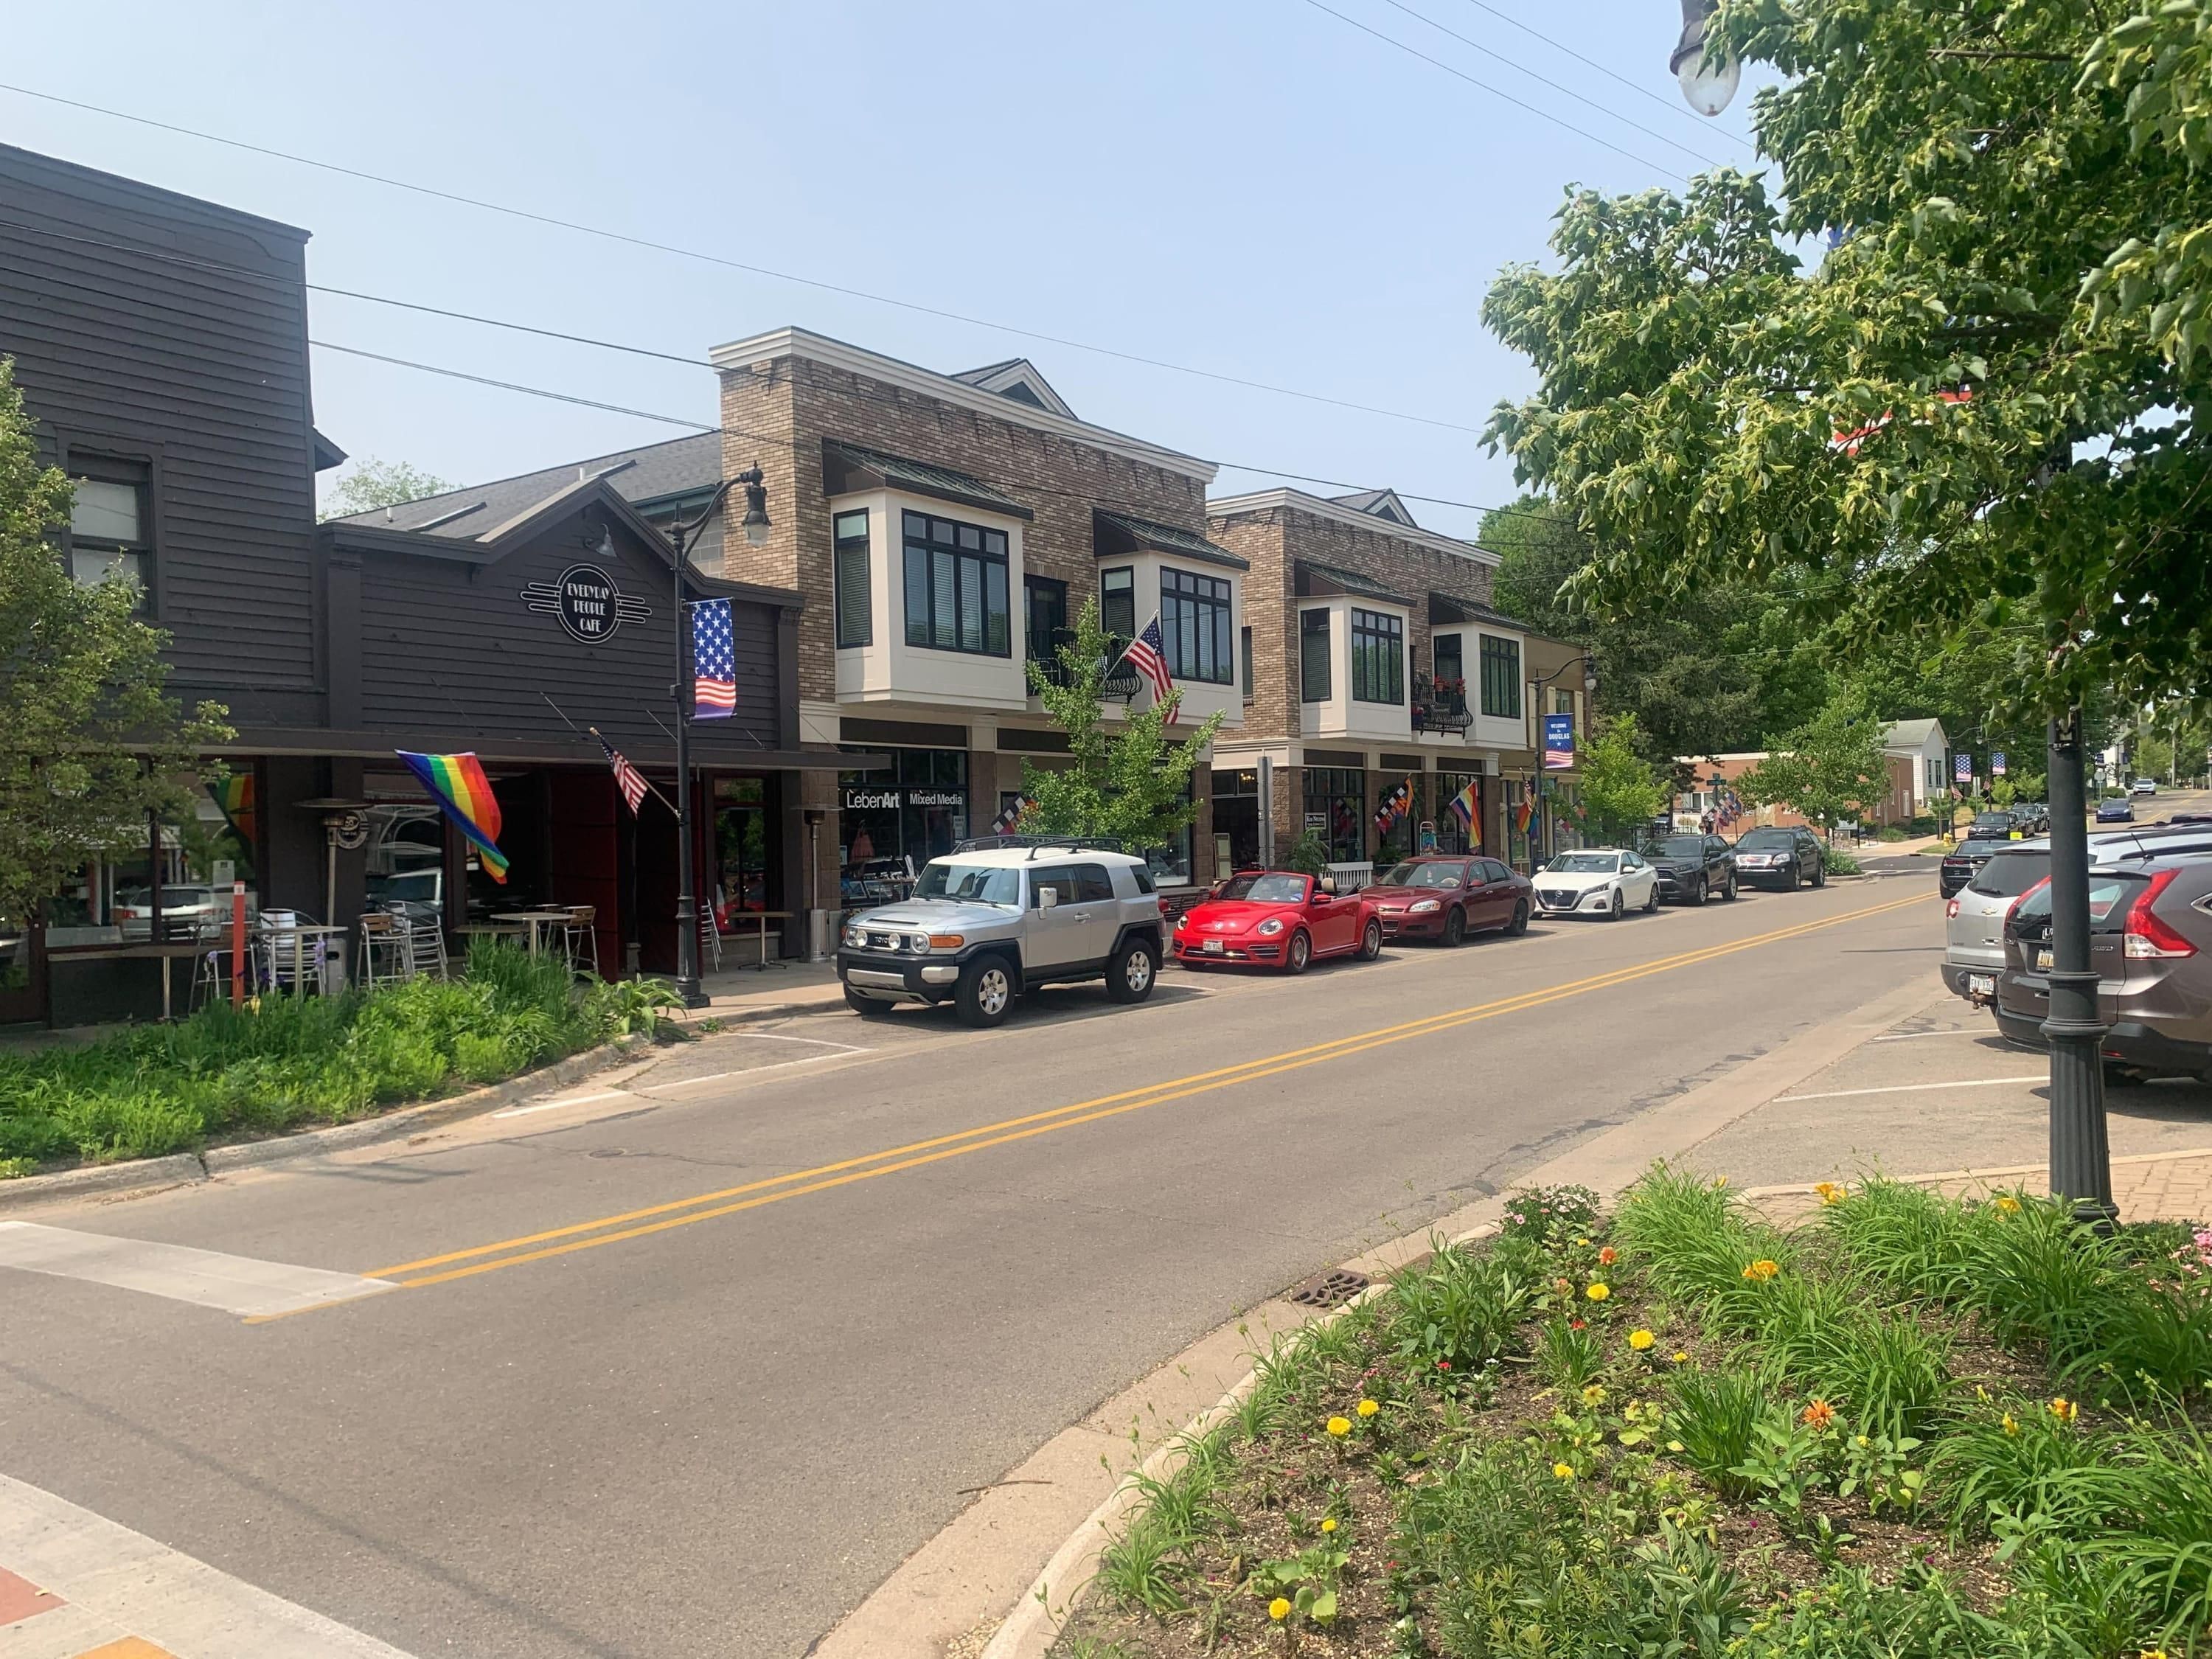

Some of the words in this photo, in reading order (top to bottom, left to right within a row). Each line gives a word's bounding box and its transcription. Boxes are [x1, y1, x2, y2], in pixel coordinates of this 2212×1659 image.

[567, 582, 611, 599] EVERYDAY
[574, 599, 606, 616] PEOPLE
[580, 617, 602, 633] CAFE
[846, 791, 900, 809] LebenArt
[910, 793, 936, 805] Mixed
[937, 794, 962, 805] Media
